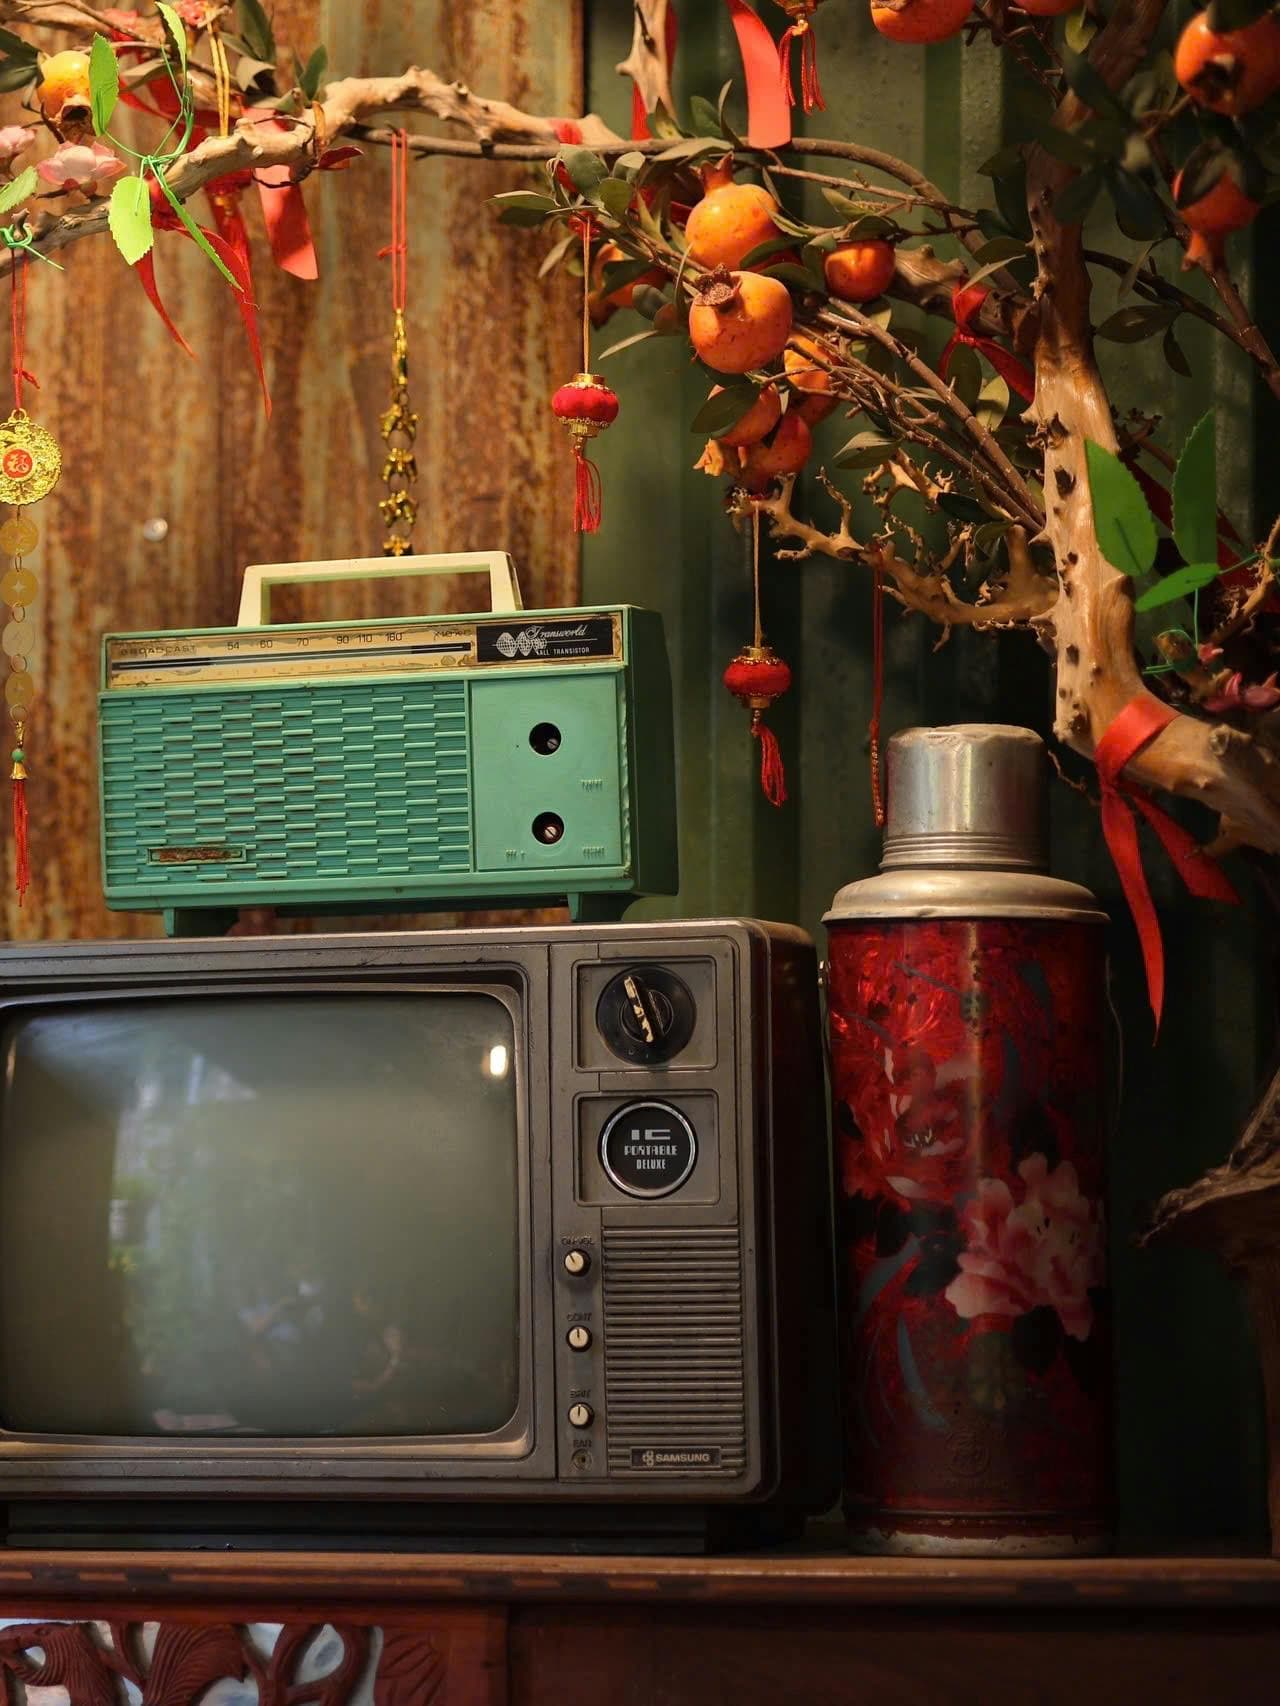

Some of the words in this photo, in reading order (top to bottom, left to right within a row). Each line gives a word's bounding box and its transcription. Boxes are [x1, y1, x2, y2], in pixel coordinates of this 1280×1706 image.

[525, 624, 588, 640] Transworld
[227, 642, 240, 651] 54
[260, 640, 273, 649] 60
[297, 637, 310, 647] 70
[336, 635, 350, 645] 90
[357, 633, 373, 643] 110
[553, 646, 591, 656] TRANSISTOR
[631, 1129, 671, 1141] IC
[624, 1145, 678, 1156] PORTABLE
[636, 1159, 666, 1170] DELUXE
[655, 1452, 711, 1463] SAMSUNG
